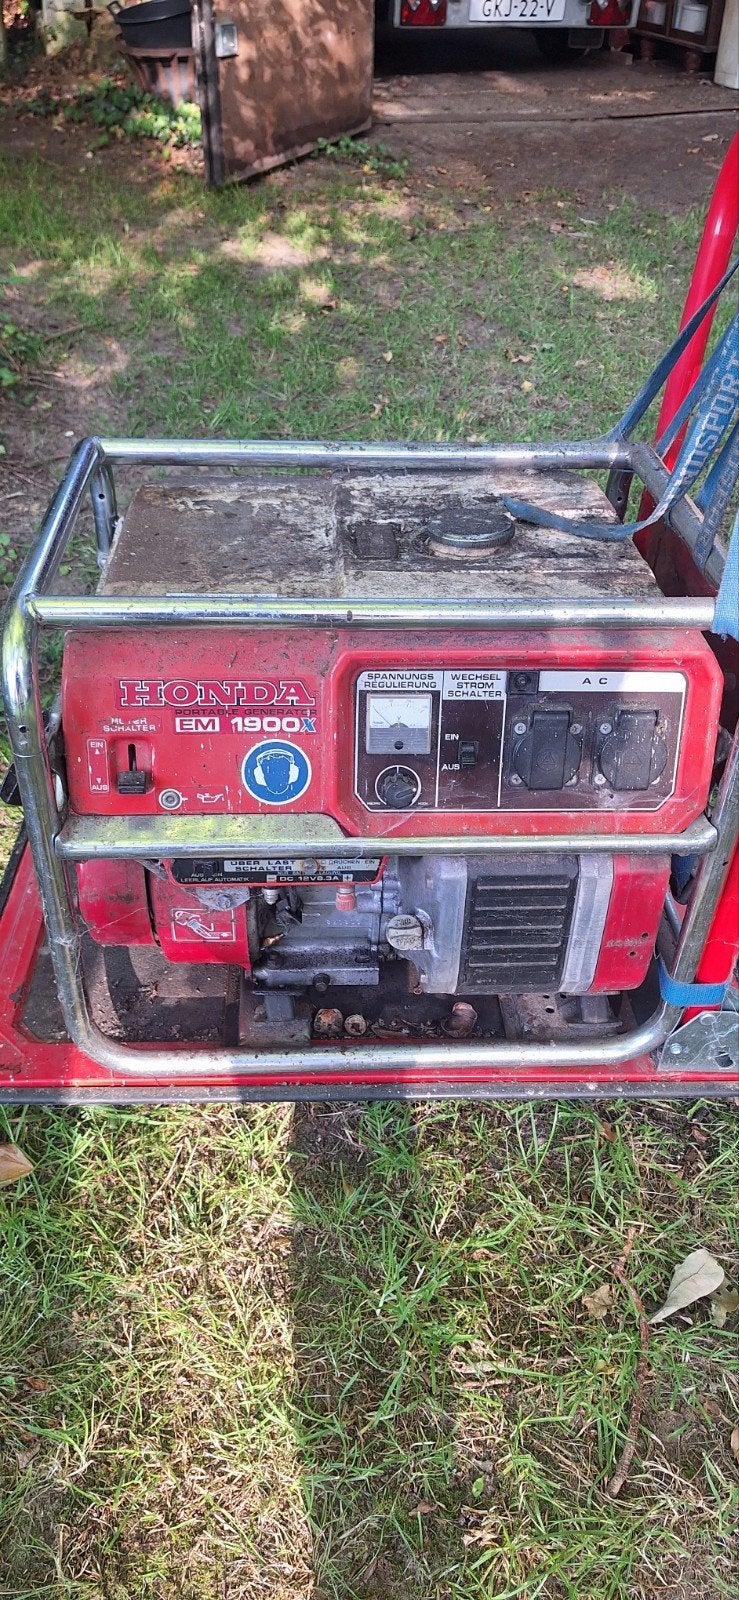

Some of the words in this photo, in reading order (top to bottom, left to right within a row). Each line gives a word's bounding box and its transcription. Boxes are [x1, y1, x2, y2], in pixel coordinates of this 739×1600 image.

[482, 0, 555, 17] GKJ-22-V
[450, 673, 502, 681] WECHSEL
[364, 681, 437, 689] REGULIERUNG
[119, 679, 316, 708] HONDA
[447, 690, 502, 698] SCHALTER
[175, 708, 239, 716] PORTABLE
[244, 708, 317, 716] GENERATOR
[103, 724, 156, 732] SCHALTER
[179, 718, 217, 731] EM
[230, 716, 317, 733] 1900X
[442, 763, 460, 771] AUS
